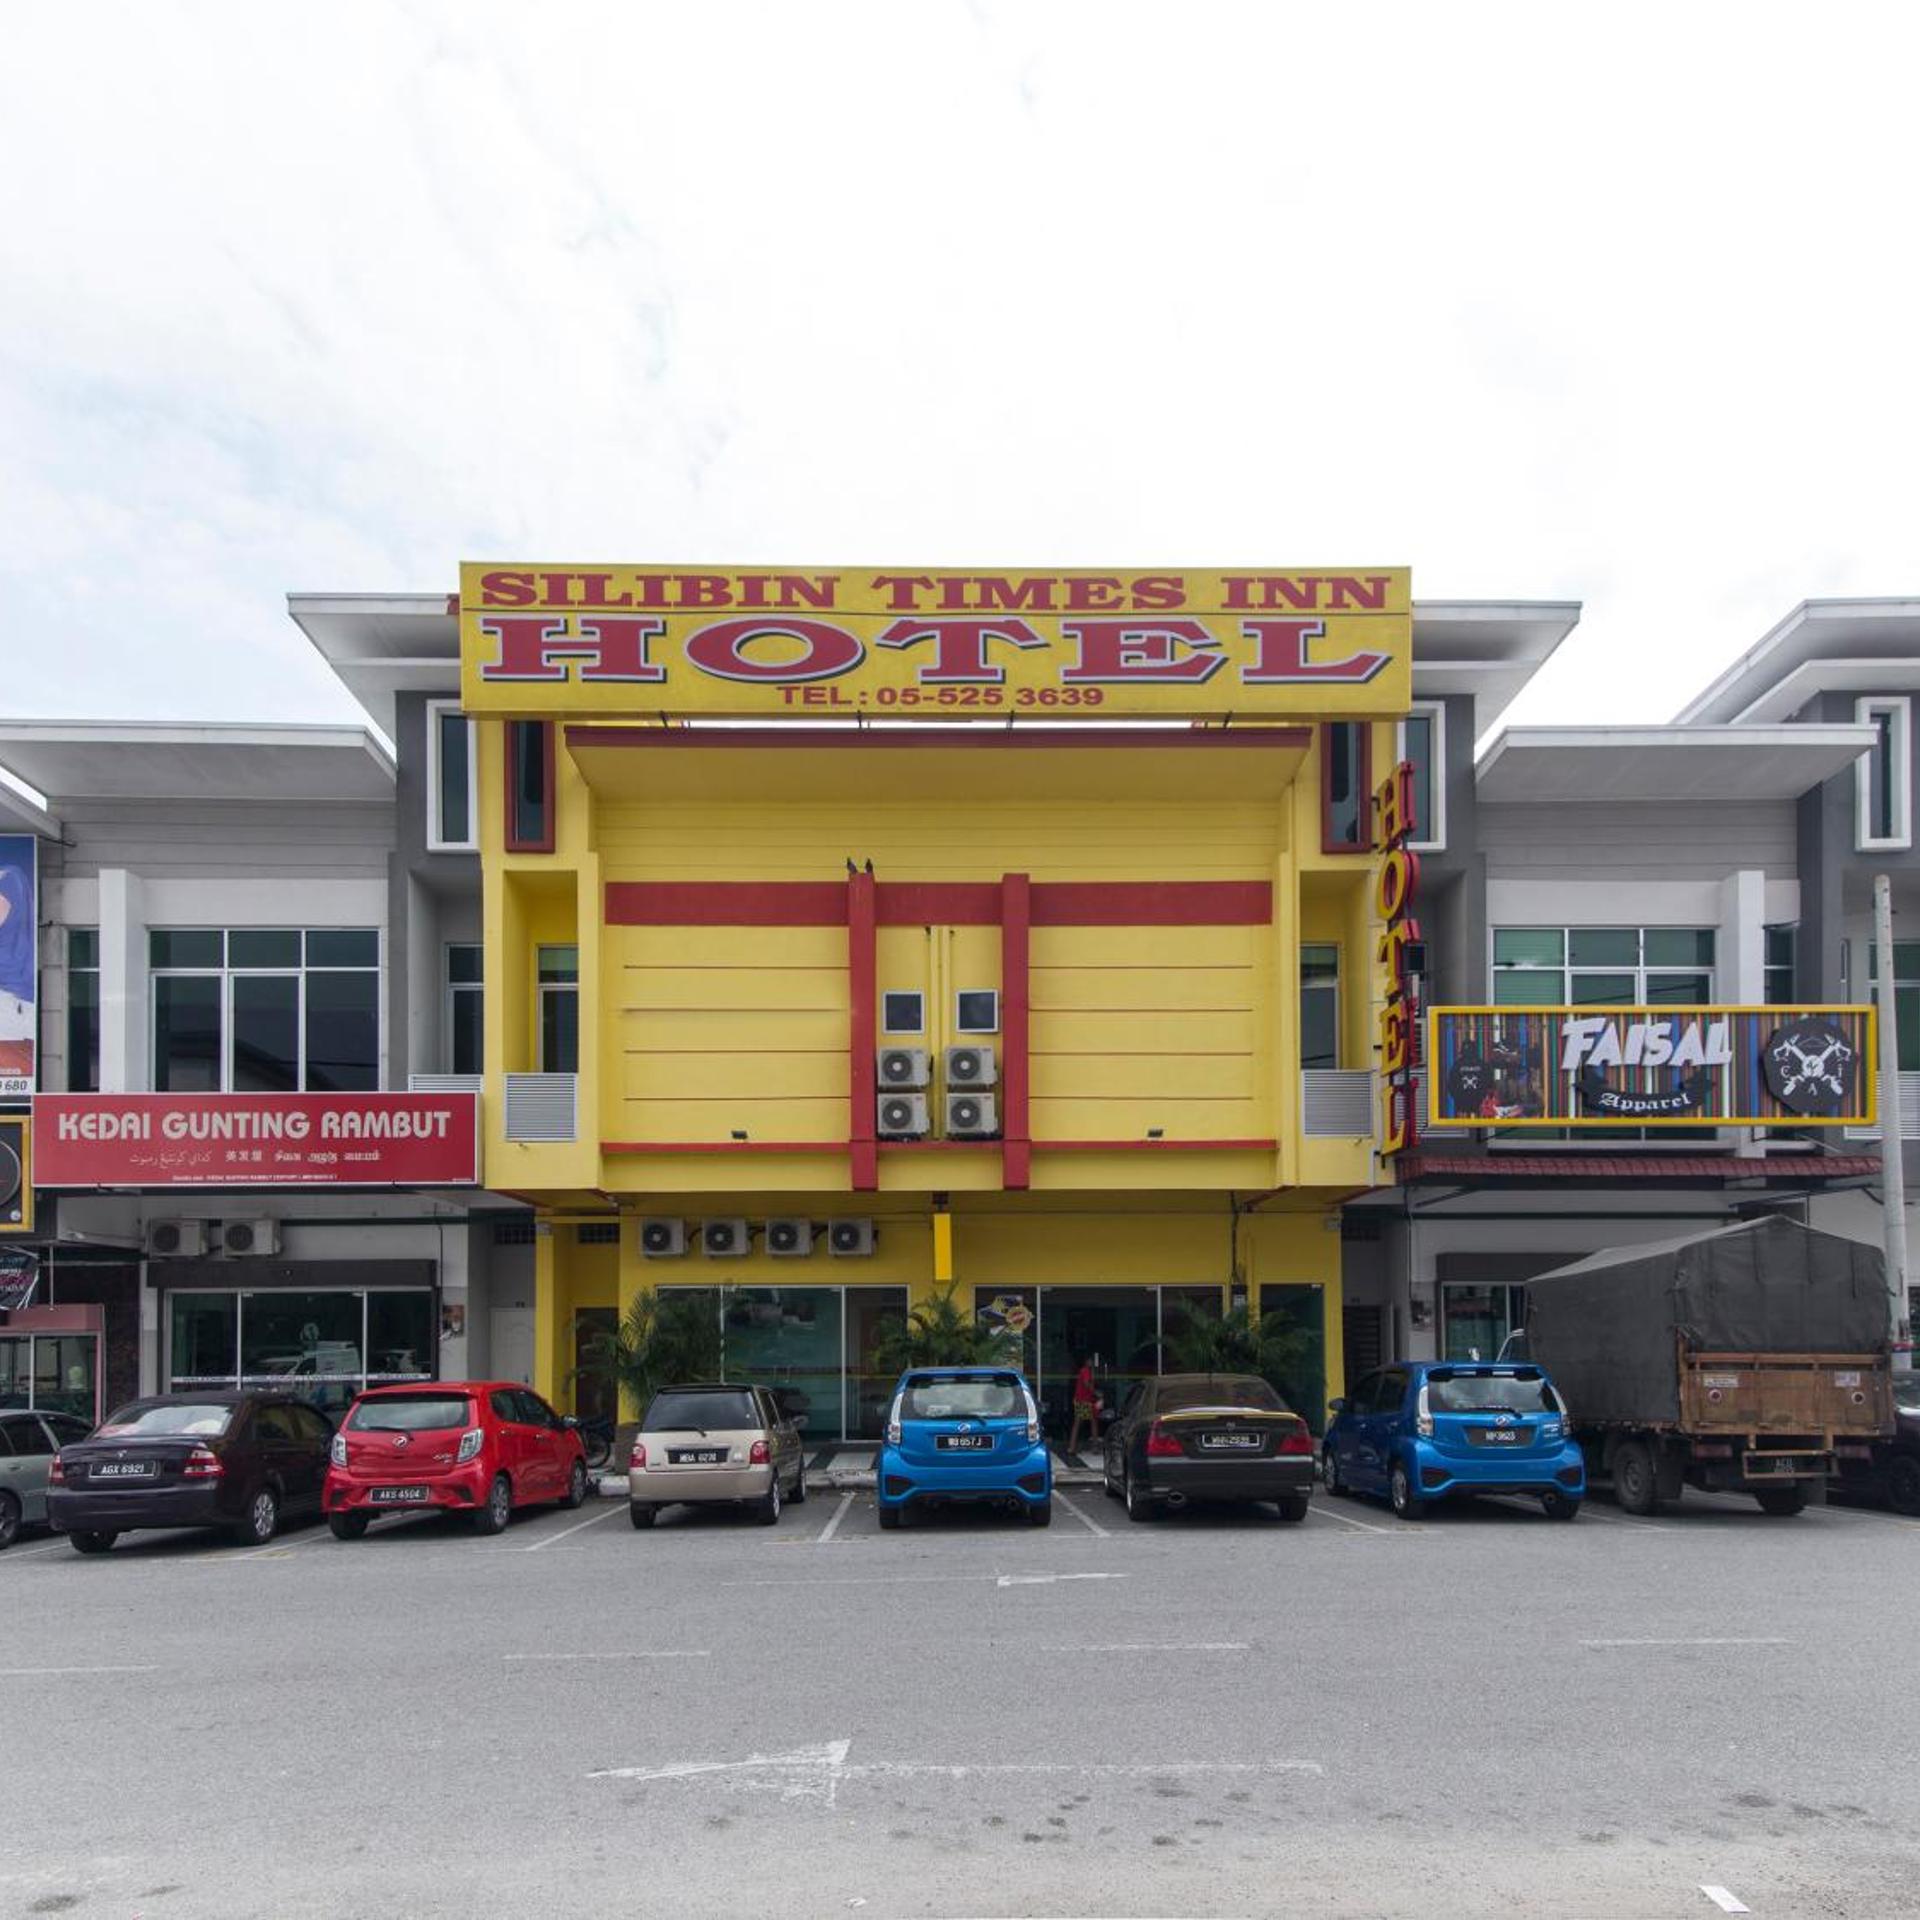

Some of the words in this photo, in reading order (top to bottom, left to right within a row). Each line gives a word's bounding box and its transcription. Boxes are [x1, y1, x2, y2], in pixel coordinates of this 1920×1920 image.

[480, 574, 836, 609] SILIBIN
[872, 576, 1185, 611] TIMES
[1222, 576, 1388, 611] INN
[481, 616, 1393, 683] HOTEL
[876, 687, 1004, 706] 05-525
[1015, 687, 1105, 706] 3639
[1377, 762, 1411, 1154] HOTEL
[1561, 1017, 1733, 1070] FAISAL
[5, 1080, 28, 1091] 680
[1600, 1090, 1692, 1112] Apparel
[58, 1111, 150, 1140] KEDAI
[161, 1111, 310, 1140] GUNTING
[321, 1111, 451, 1139] RAMBUT
